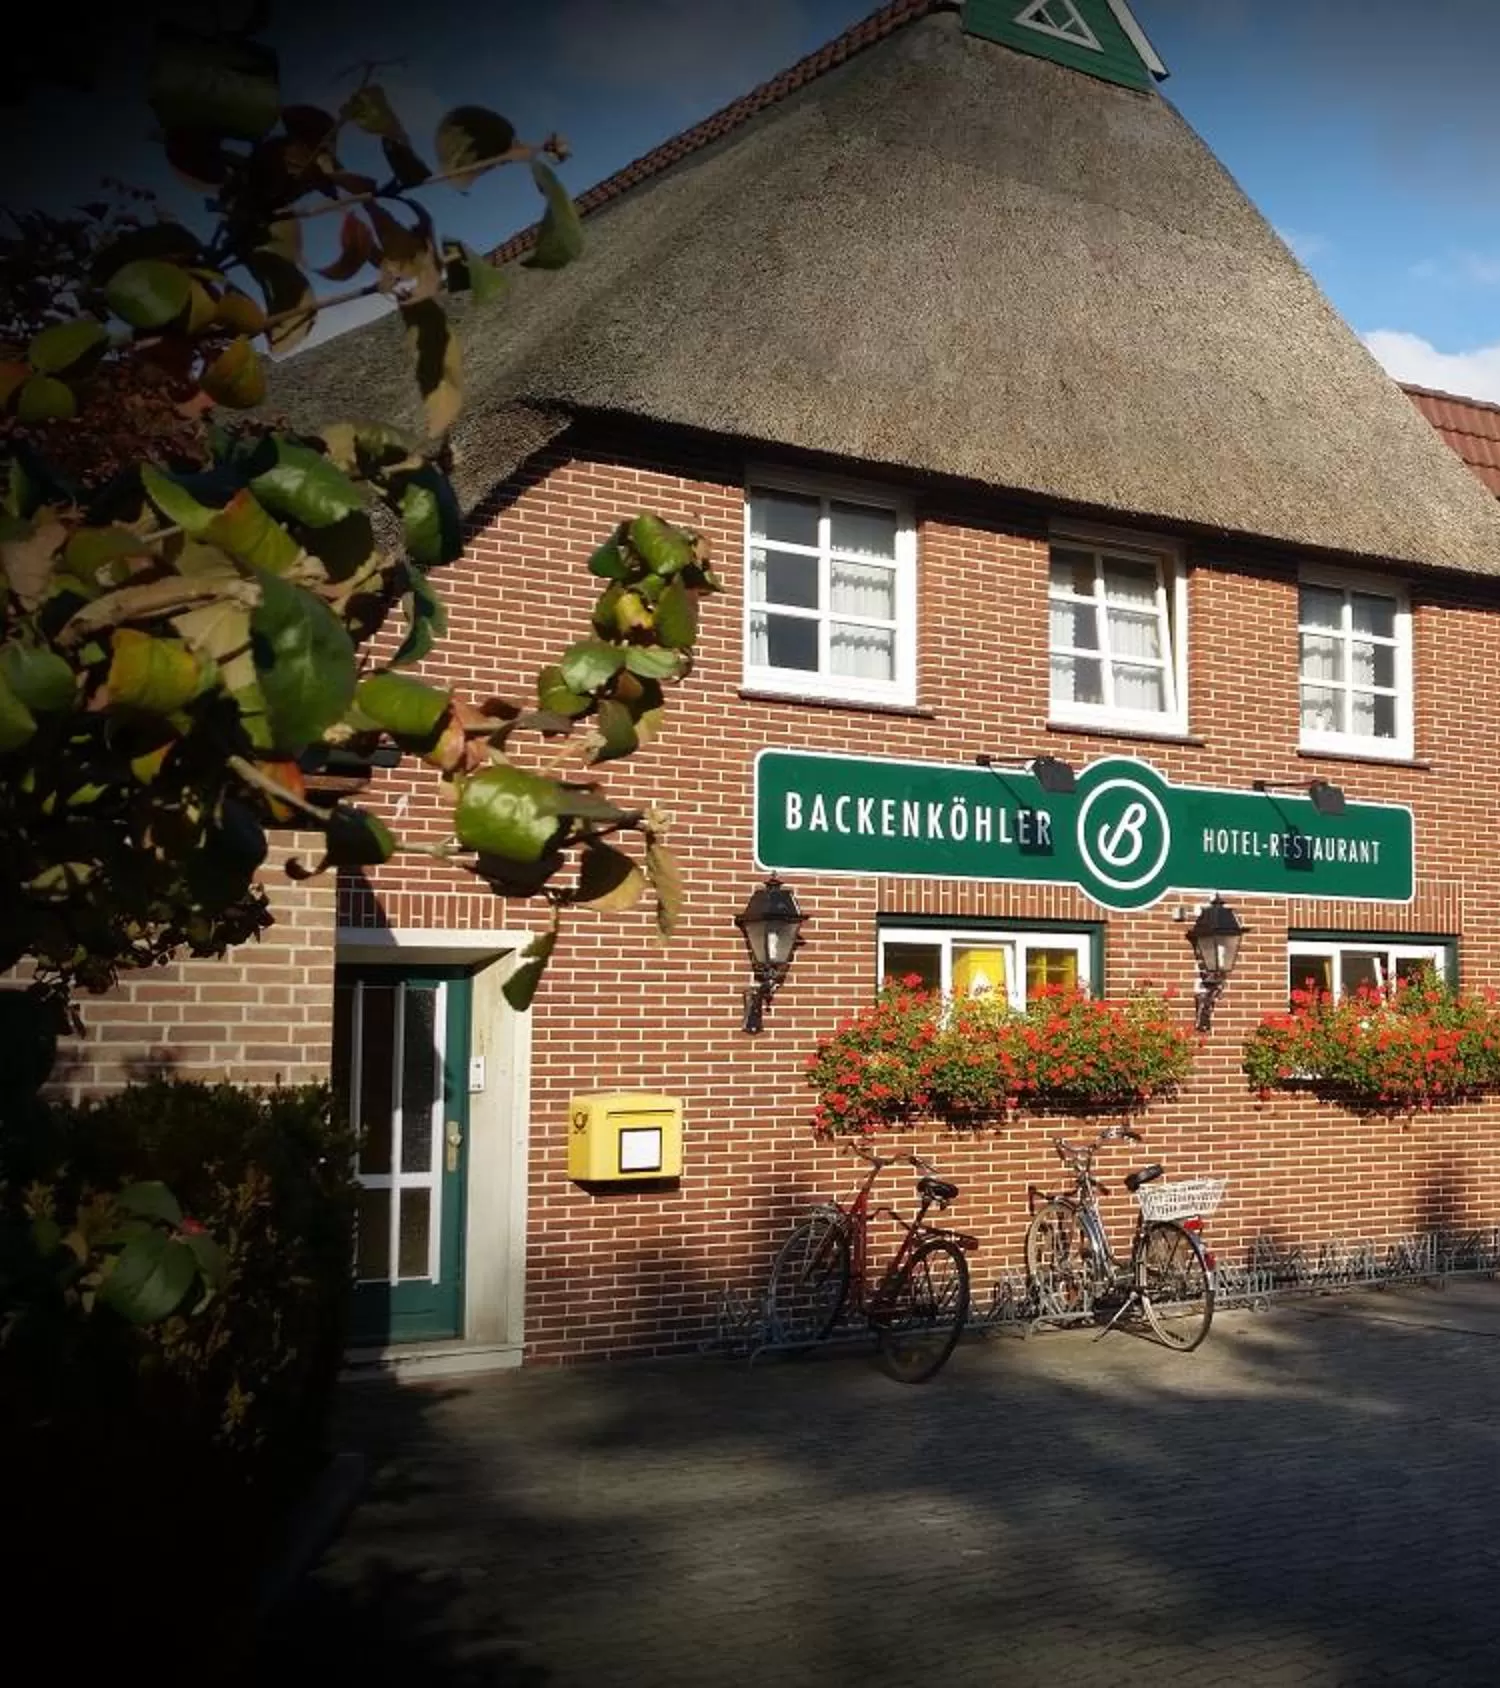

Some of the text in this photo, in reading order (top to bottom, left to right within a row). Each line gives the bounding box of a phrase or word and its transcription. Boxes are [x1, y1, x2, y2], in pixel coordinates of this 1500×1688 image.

[785, 791, 1051, 846] BACKENKÖHLER
[1097, 802, 1147, 867] B
[1202, 827, 1381, 865] HOTEL-RESTAURANT
